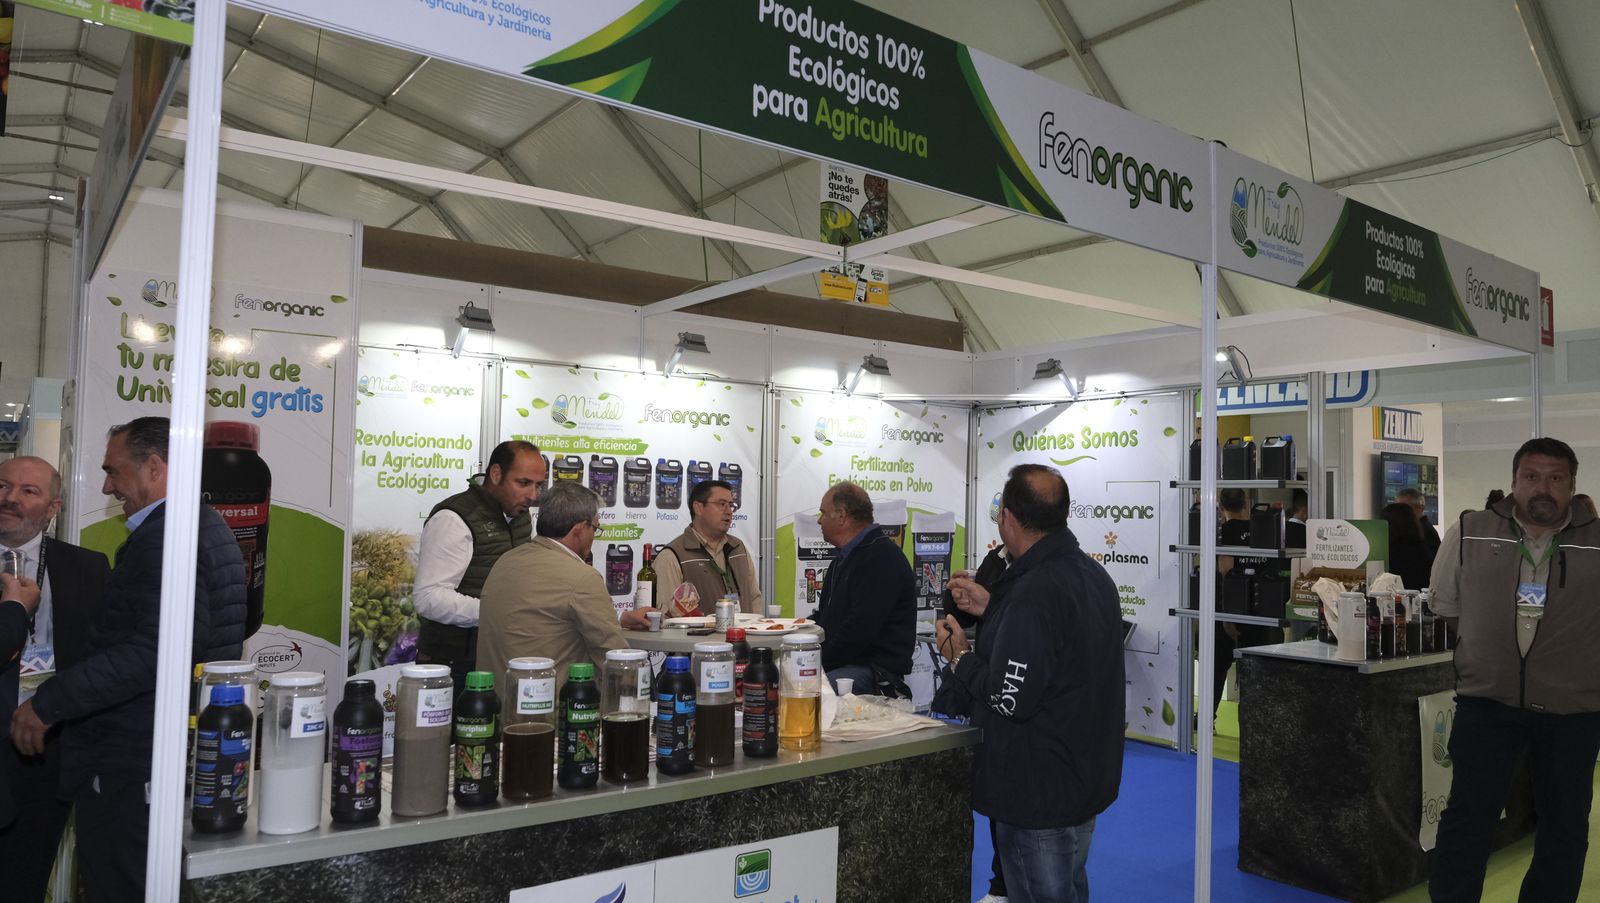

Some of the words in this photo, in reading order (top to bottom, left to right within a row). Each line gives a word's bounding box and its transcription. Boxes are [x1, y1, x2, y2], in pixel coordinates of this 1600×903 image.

[491, 0, 551, 25] Ecológicos
[487, 13, 495, 26] y
[497, 14, 551, 41] Jardinería
[758, 0, 869, 59] Productos
[876, 33, 926, 80] 100%
[788, 44, 900, 110] Ecológicos
[752, 83, 808, 123] para
[815, 96, 928, 158] Agricultura
[1039, 111, 1194, 212] fenorganic
[828, 182, 860, 195] quedes
[845, 175, 853, 184] te
[828, 191, 853, 203] atrás!
[1247, 182, 1304, 246] Mendel
[1365, 220, 1404, 252] Productos
[1405, 235, 1424, 259] 100%
[1376, 250, 1416, 280] Ecológicos
[1365, 275, 1385, 295] para
[1386, 281, 1426, 306] Agricultura
[1465, 267, 1530, 324] fenorganic
[234, 293, 325, 317] fenorganic
[116, 342, 144, 370] tu
[153, 350, 260, 379] mstra
[269, 356, 300, 382] de
[117, 374, 247, 408] Univsal
[251, 386, 324, 418] gratis
[567, 395, 624, 421] Mendel
[643, 402, 731, 429] fenorganic
[1383, 410, 1425, 442] ZENLAND
[354, 428, 473, 451] Revolucionando
[573, 438, 591, 449] alta
[593, 438, 638, 452] eficiencia
[881, 424, 944, 446] fenorganic
[1012, 427, 1075, 452] Quiénes
[1081, 425, 1139, 449] Somos
[361, 450, 377, 467] la
[382, 451, 464, 473] Agricultura
[851, 455, 915, 474] Fertilizantes
[376, 471, 450, 495] Ecológica
[889, 478, 903, 492] en
[906, 477, 933, 493] Polvo
[213, 506, 258, 517] versal
[599, 512, 616, 521] sforo
[625, 512, 647, 520] Hierro
[656, 512, 679, 521] Potasio
[1069, 500, 1154, 524] fenorganic
[1311, 552, 1326, 561] 100%
[1315, 543, 1354, 553] FERTILIZANTES
[1118, 584, 1136, 594] años
[1120, 595, 1146, 606] oductos
[258, 654, 295, 663] ECOCERT
[571, 711, 600, 721] Nutripl
